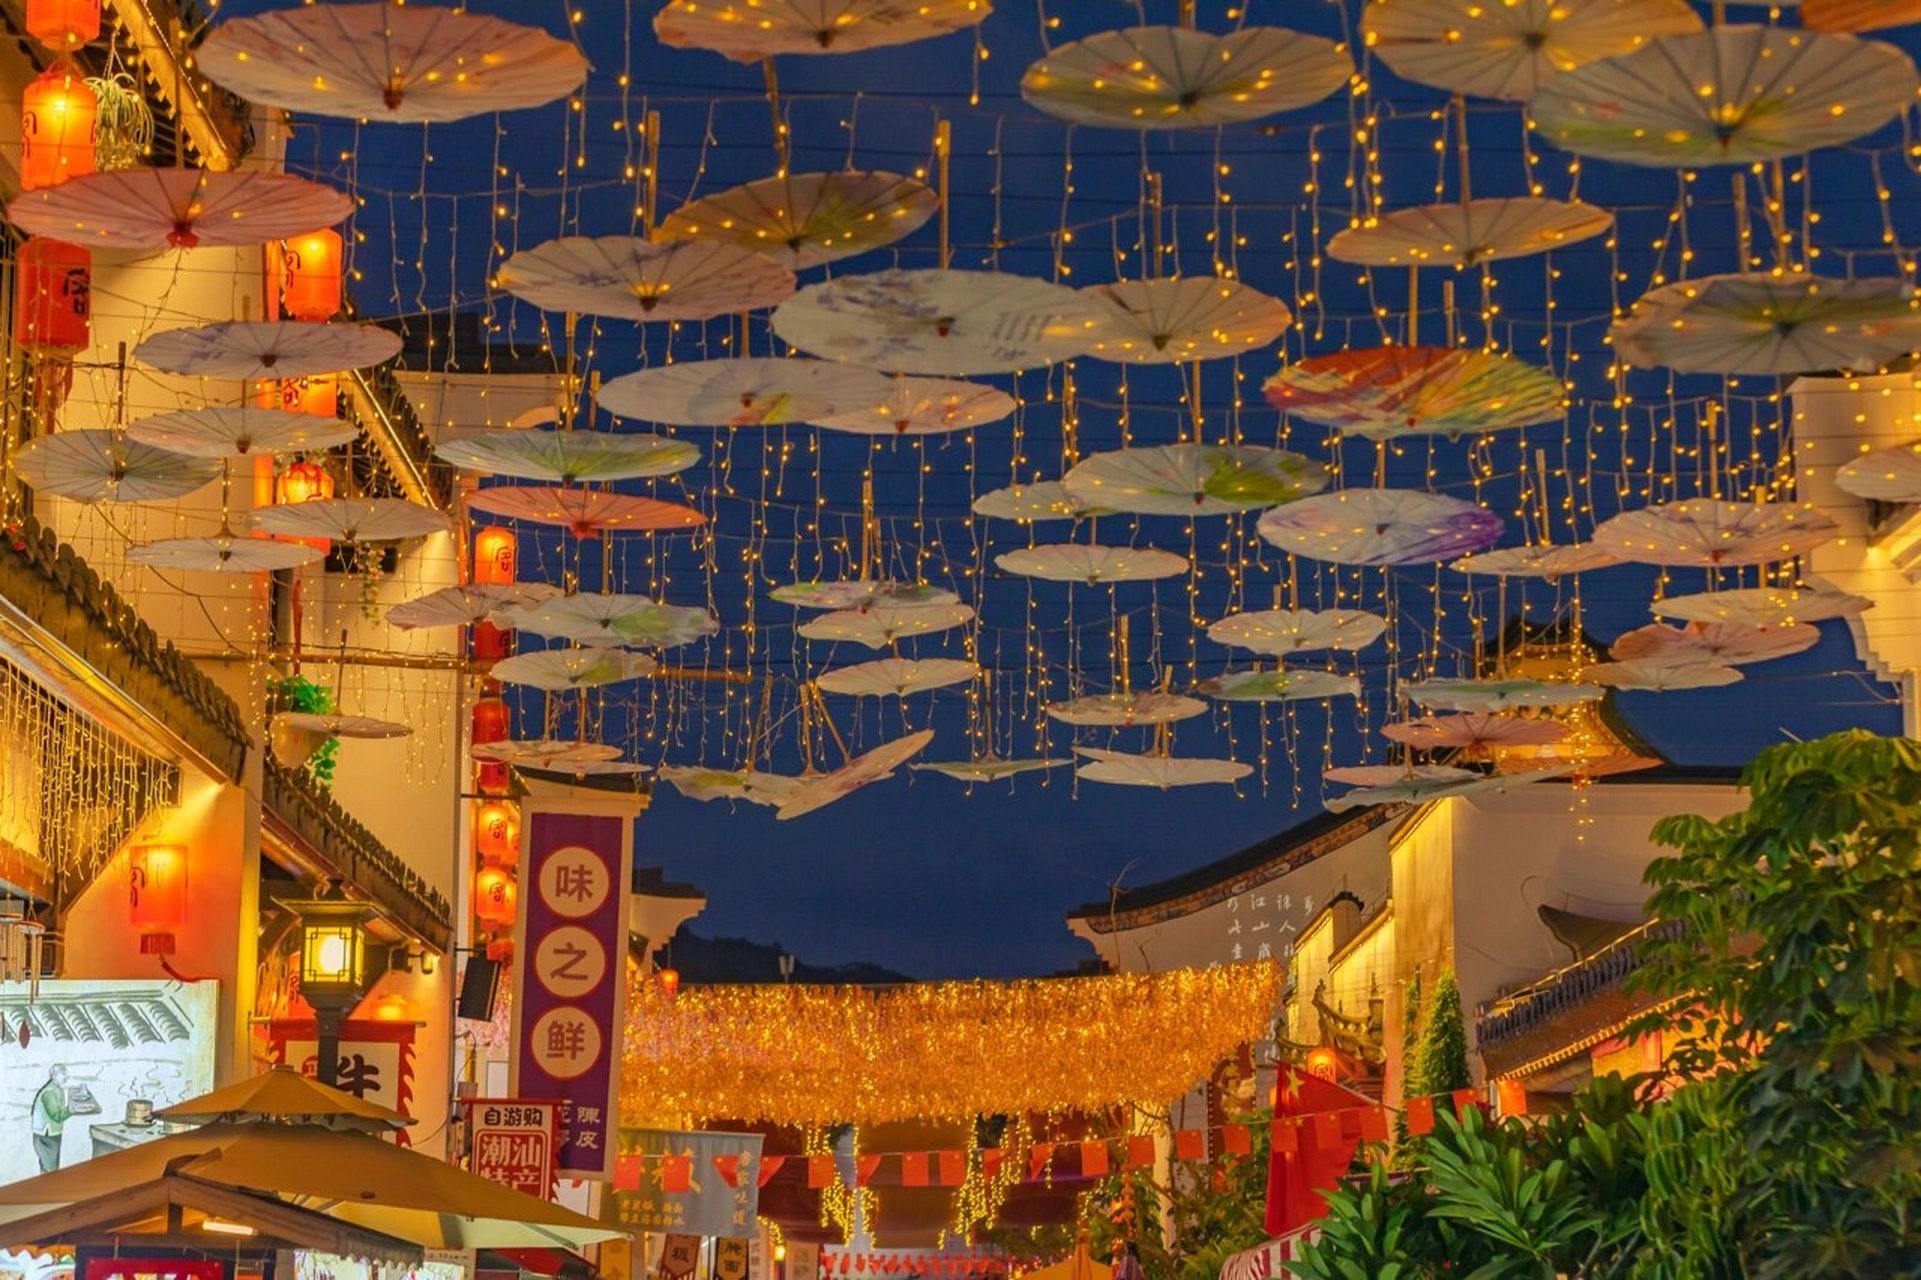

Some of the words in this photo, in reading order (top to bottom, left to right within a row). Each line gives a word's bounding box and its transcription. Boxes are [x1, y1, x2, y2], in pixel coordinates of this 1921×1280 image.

[546, 864, 593, 1061] 味之鲜
[336, 1053, 382, 1100] 牛
[484, 1107, 543, 1127] 自游购
[576, 1106, 601, 1150] 陳皮
[480, 1135, 541, 1167] 潮汕
